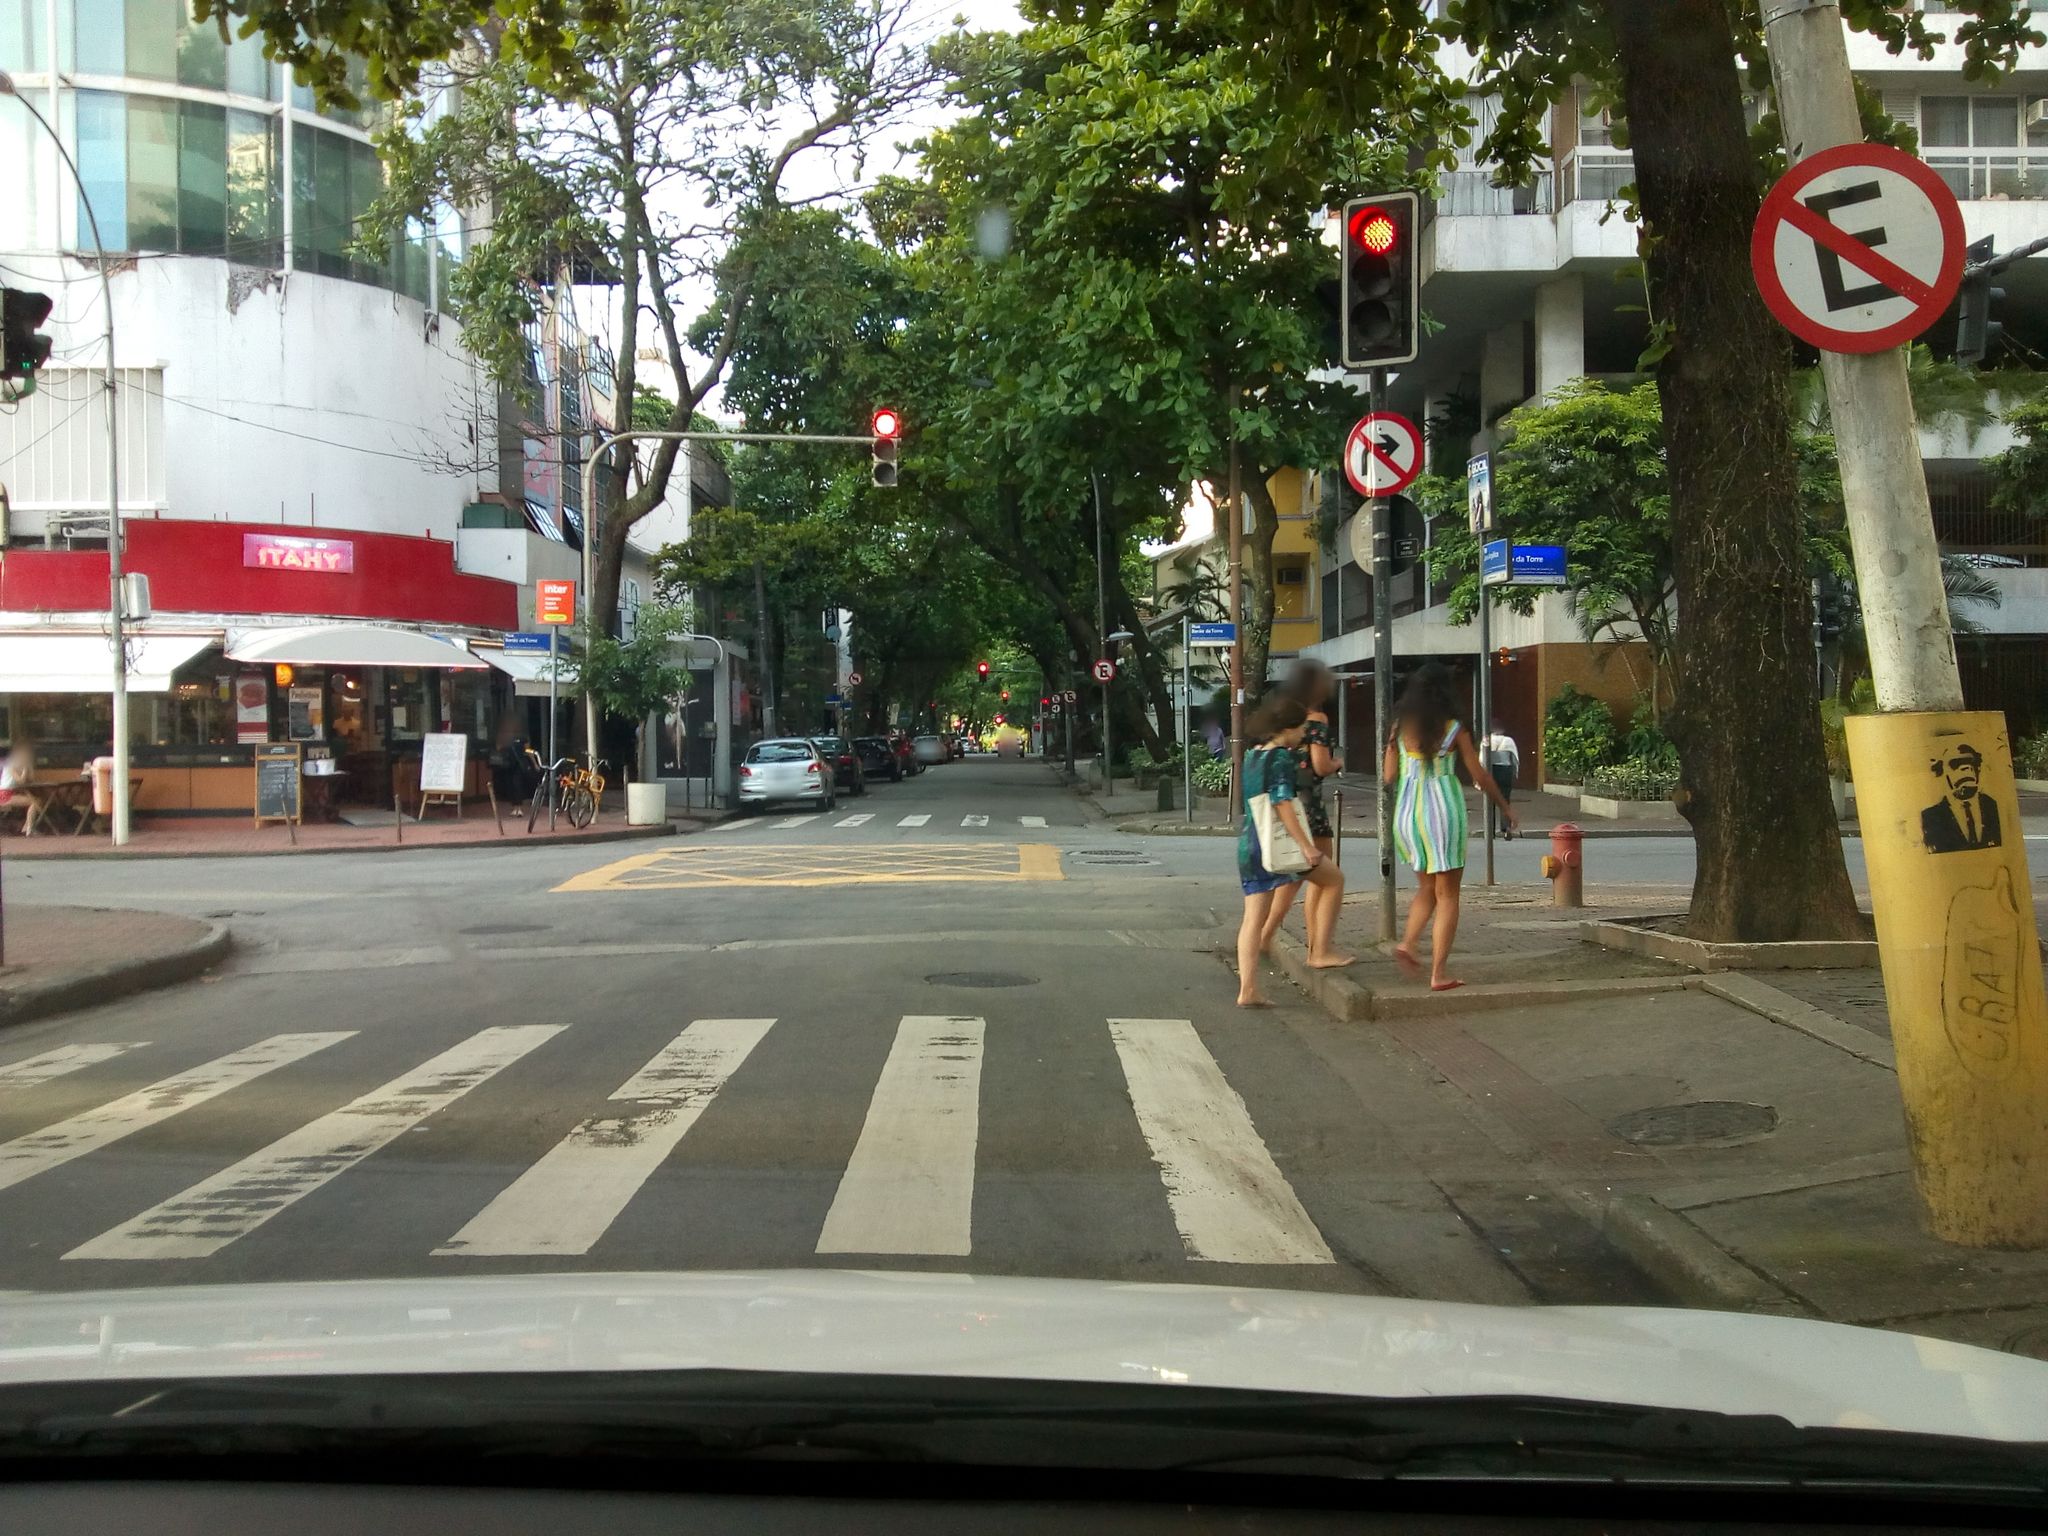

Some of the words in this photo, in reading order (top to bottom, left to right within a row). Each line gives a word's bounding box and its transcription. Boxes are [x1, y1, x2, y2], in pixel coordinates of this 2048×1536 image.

[1804, 180, 1902, 312] E
[258, 547, 340, 569] ITAHY
[1525, 555, 1544, 563] Torre
